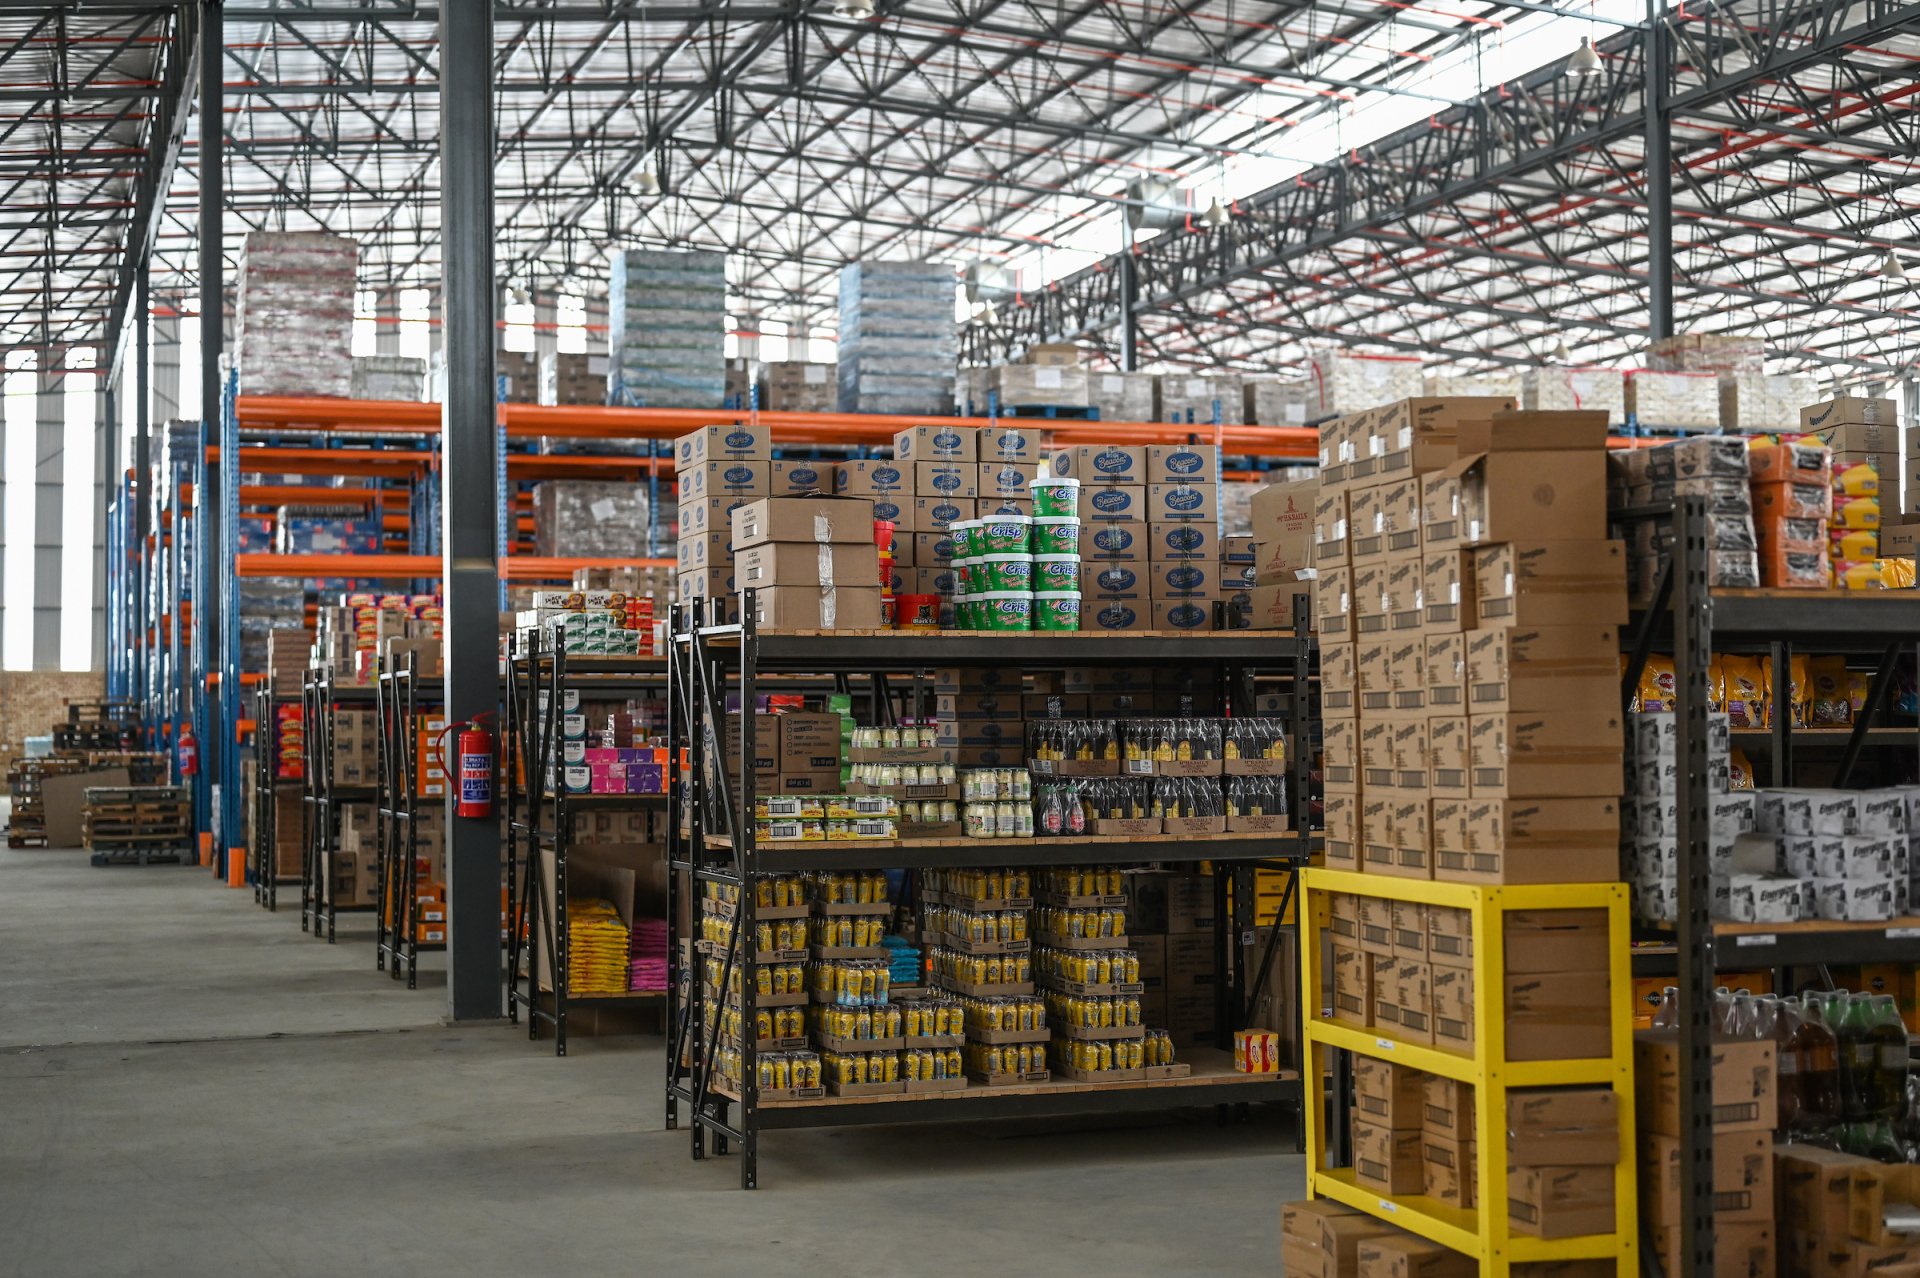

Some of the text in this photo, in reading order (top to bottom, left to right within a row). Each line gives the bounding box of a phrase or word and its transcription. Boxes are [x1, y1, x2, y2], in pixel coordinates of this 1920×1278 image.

[1099, 454, 1126, 469] Beacon
[1170, 455, 1197, 470] Beacon
[1056, 489, 1076, 500] Cris
[1097, 493, 1124, 507] Beacon
[1169, 494, 1196, 507] Beacon
[991, 526, 1022, 539] Crisp
[1056, 527, 1077, 538] Cris
[545, 595, 562, 603] SNACK
[588, 595, 604, 603] SNACK
[1059, 601, 1079, 612] Cris
[1760, 884, 1799, 902] Energizer
